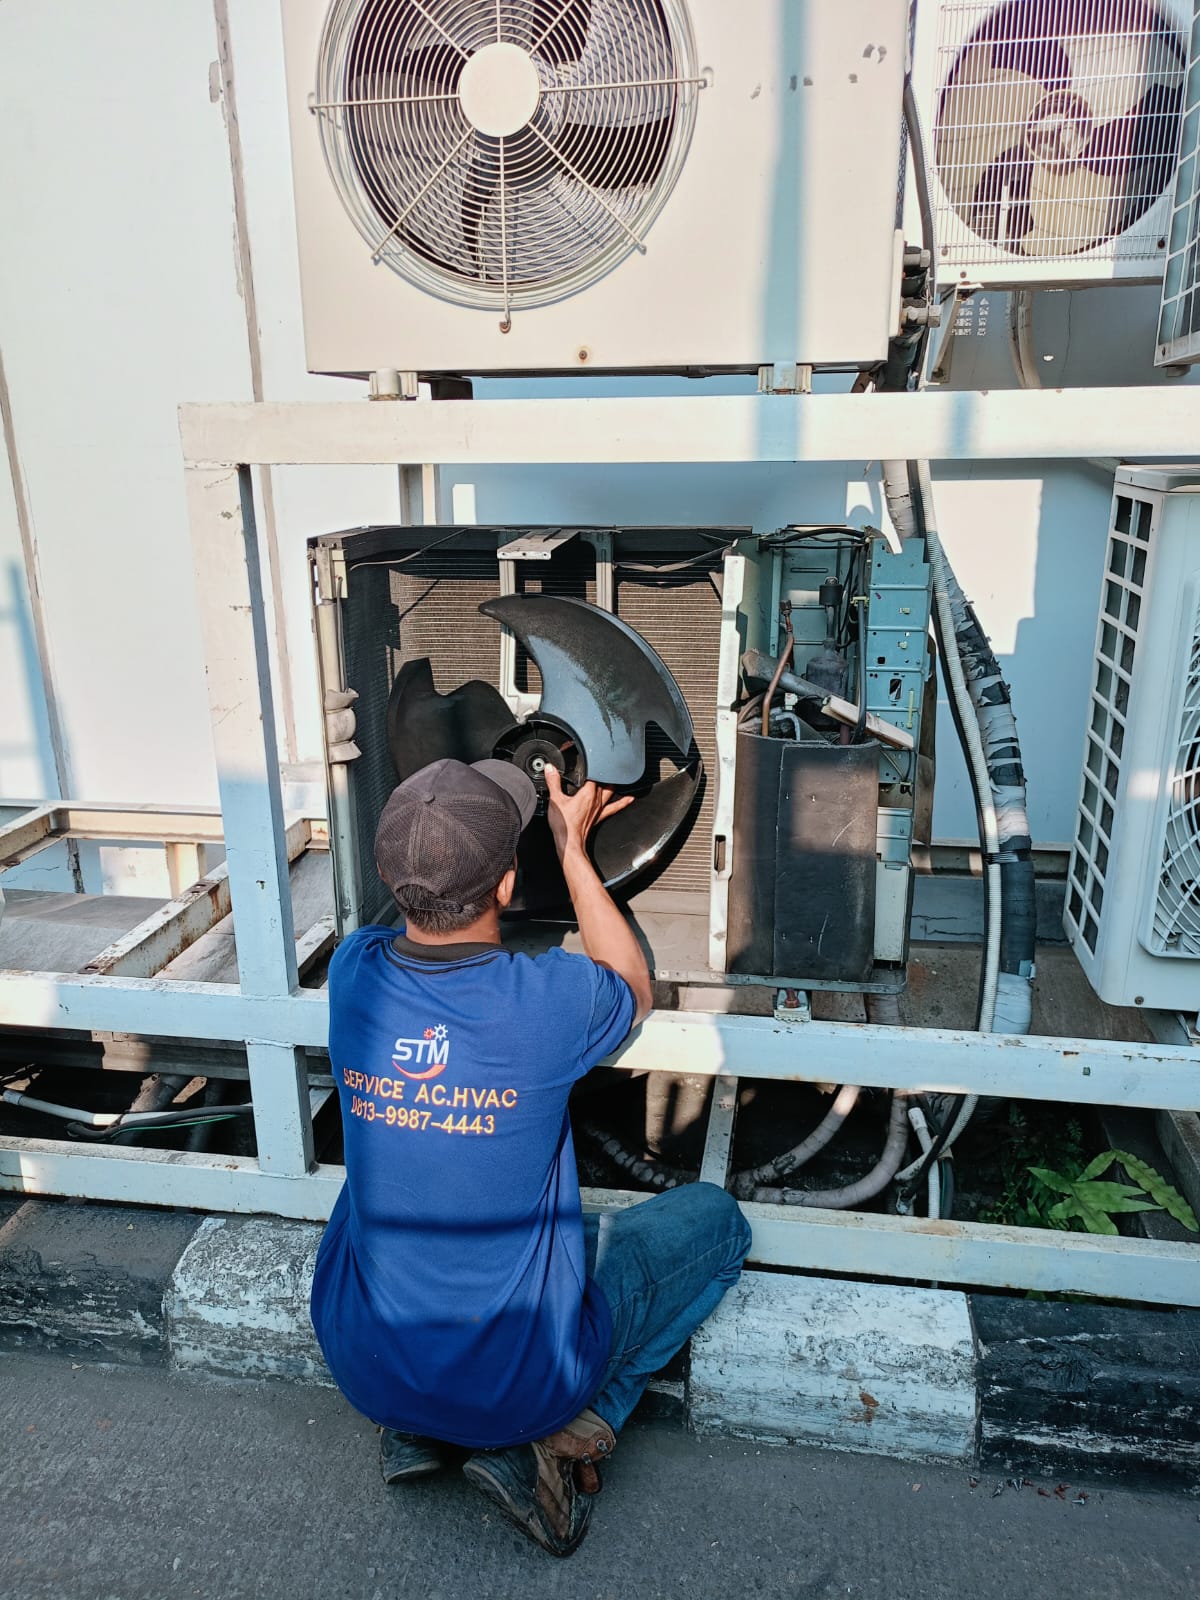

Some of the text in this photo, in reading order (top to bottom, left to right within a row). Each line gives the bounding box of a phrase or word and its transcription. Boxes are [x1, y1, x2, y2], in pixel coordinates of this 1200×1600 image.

[392, 1038, 450, 1064] STM
[343, 1066, 518, 1109] SERVICE AC.HVAC
[351, 1095, 495, 1135] 0813-9987-4443
